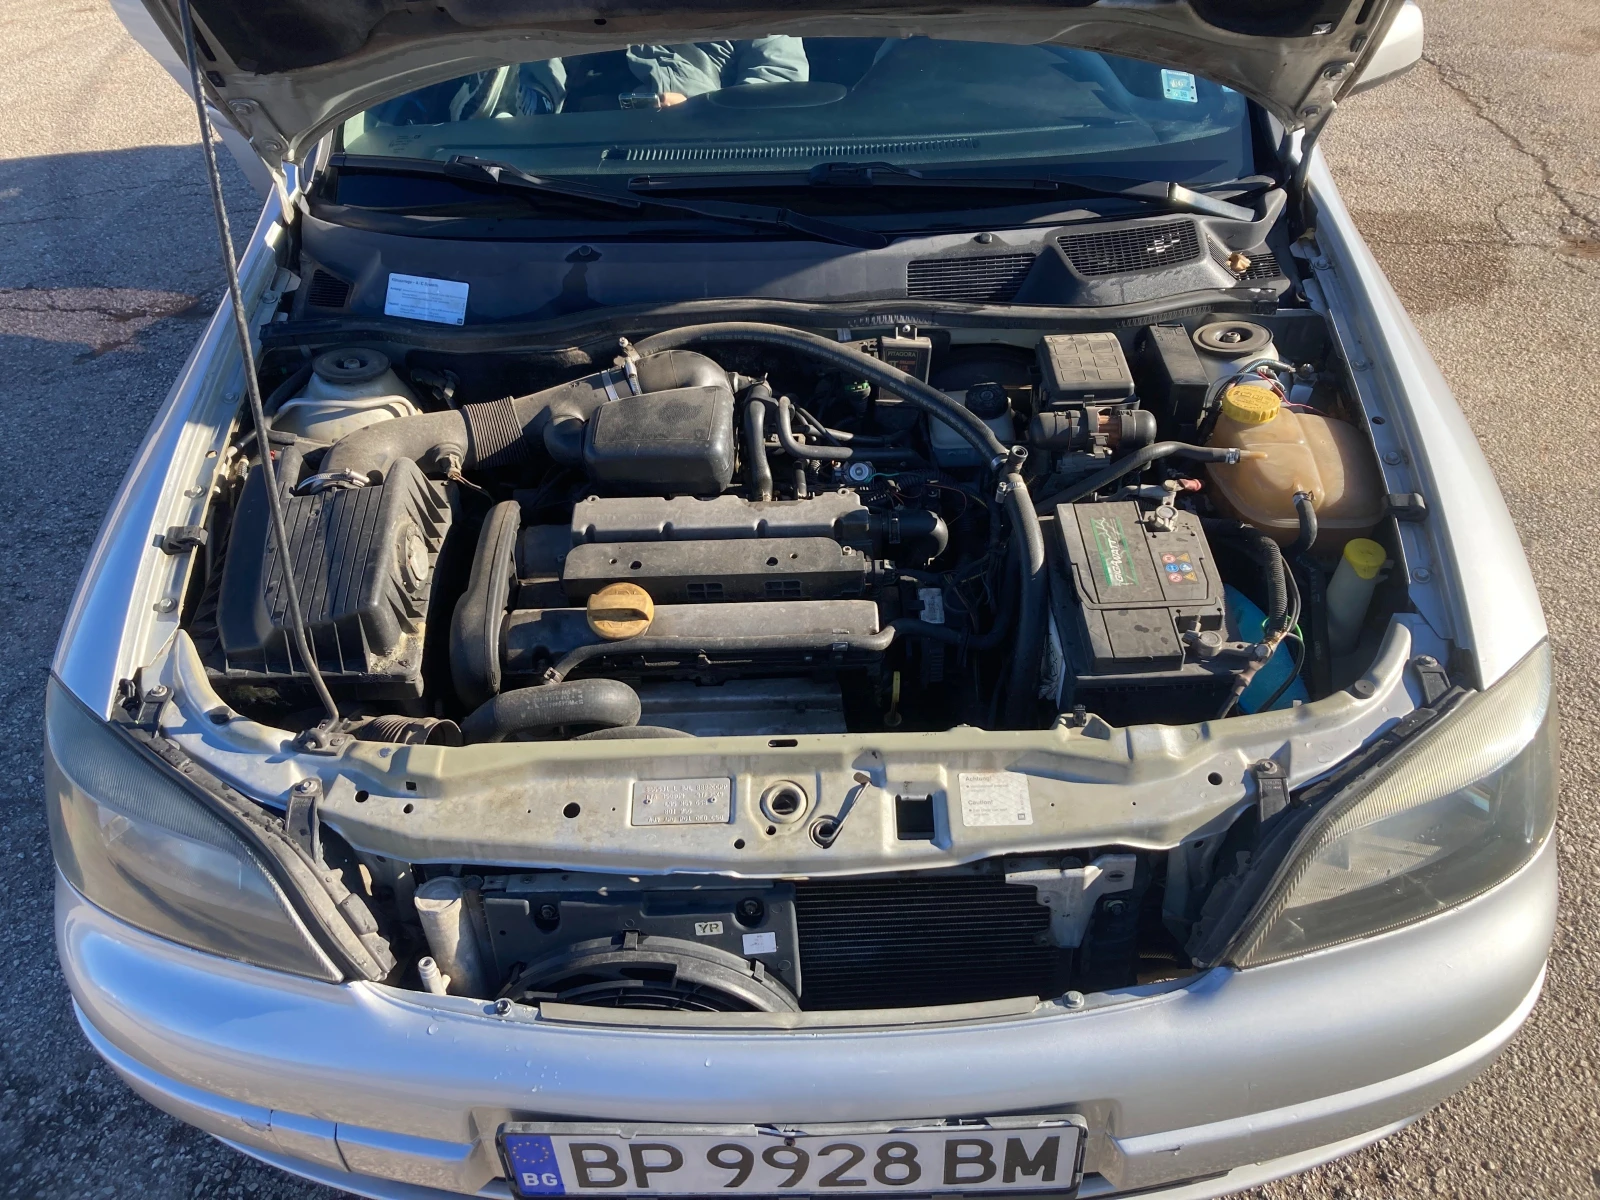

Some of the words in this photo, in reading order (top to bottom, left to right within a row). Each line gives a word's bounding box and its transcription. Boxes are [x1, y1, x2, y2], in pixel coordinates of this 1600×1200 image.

[1108, 537, 1124, 583] GIGAWATT
[522, 1172, 558, 1187] BG
[568, 1142, 684, 1189] BP
[706, 1141, 922, 1188] 9928
[942, 1136, 1061, 1185] BM
